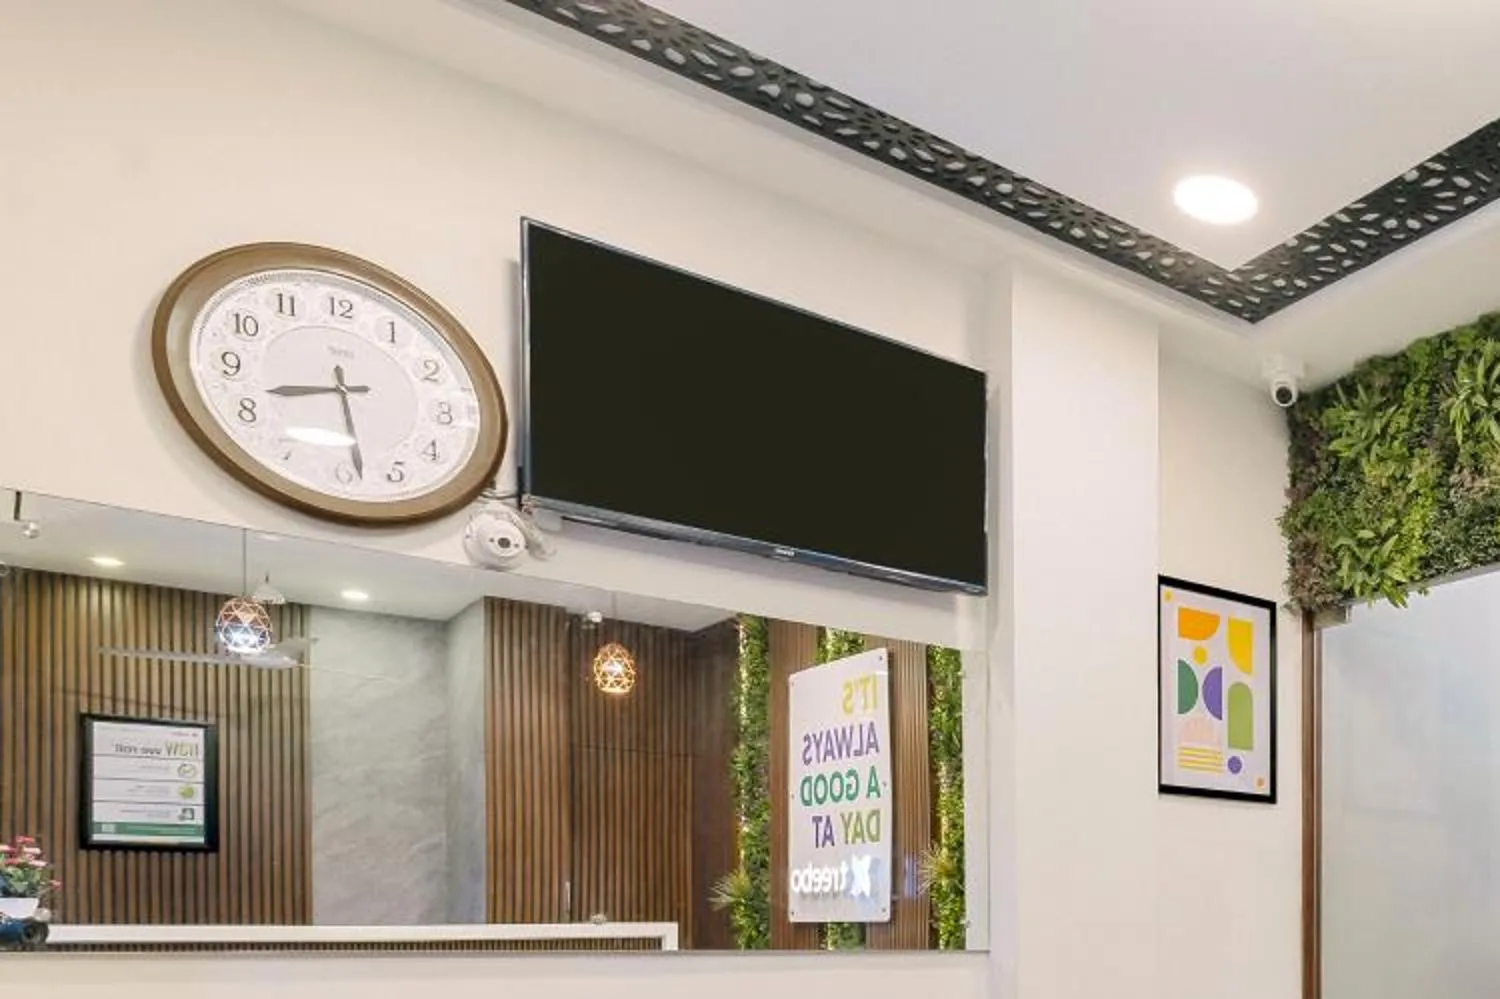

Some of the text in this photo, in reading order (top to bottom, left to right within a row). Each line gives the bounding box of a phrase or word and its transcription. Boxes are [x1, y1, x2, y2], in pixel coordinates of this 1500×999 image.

[277, 293, 295, 316] 11
[329, 297, 353, 319] 12
[234, 313, 259, 337] 10
[388, 322, 396, 343] 1
[221, 351, 241, 376] 9
[424, 360, 440, 381] 2
[238, 398, 257, 423] 8
[437, 402, 453, 425] 3
[420, 439, 438, 461] 4
[387, 461, 404, 482] 5
